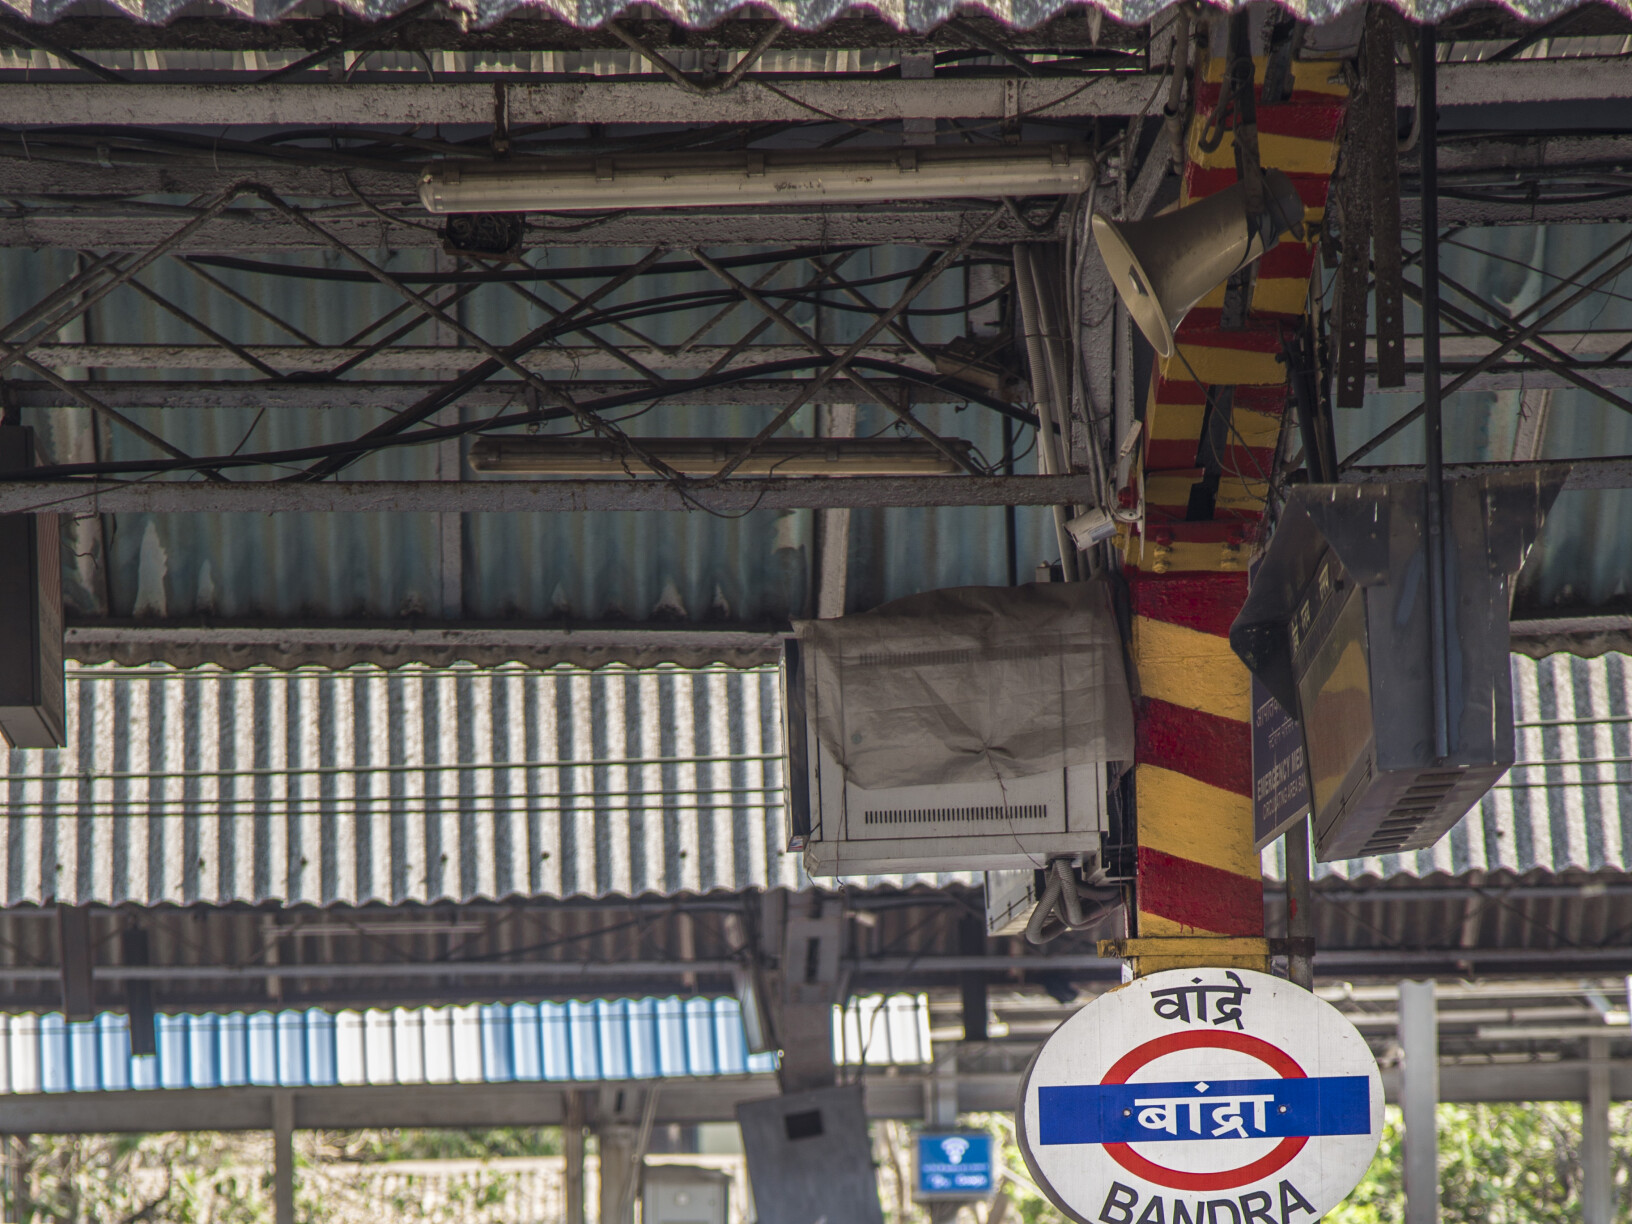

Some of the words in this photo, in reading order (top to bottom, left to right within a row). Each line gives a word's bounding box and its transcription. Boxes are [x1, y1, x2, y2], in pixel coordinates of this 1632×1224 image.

[1257, 754, 1291, 801] EMERGENCY
[1150, 970, 1252, 1030] वांद्रे
[1134, 1081, 1275, 1138] बांद्रा
